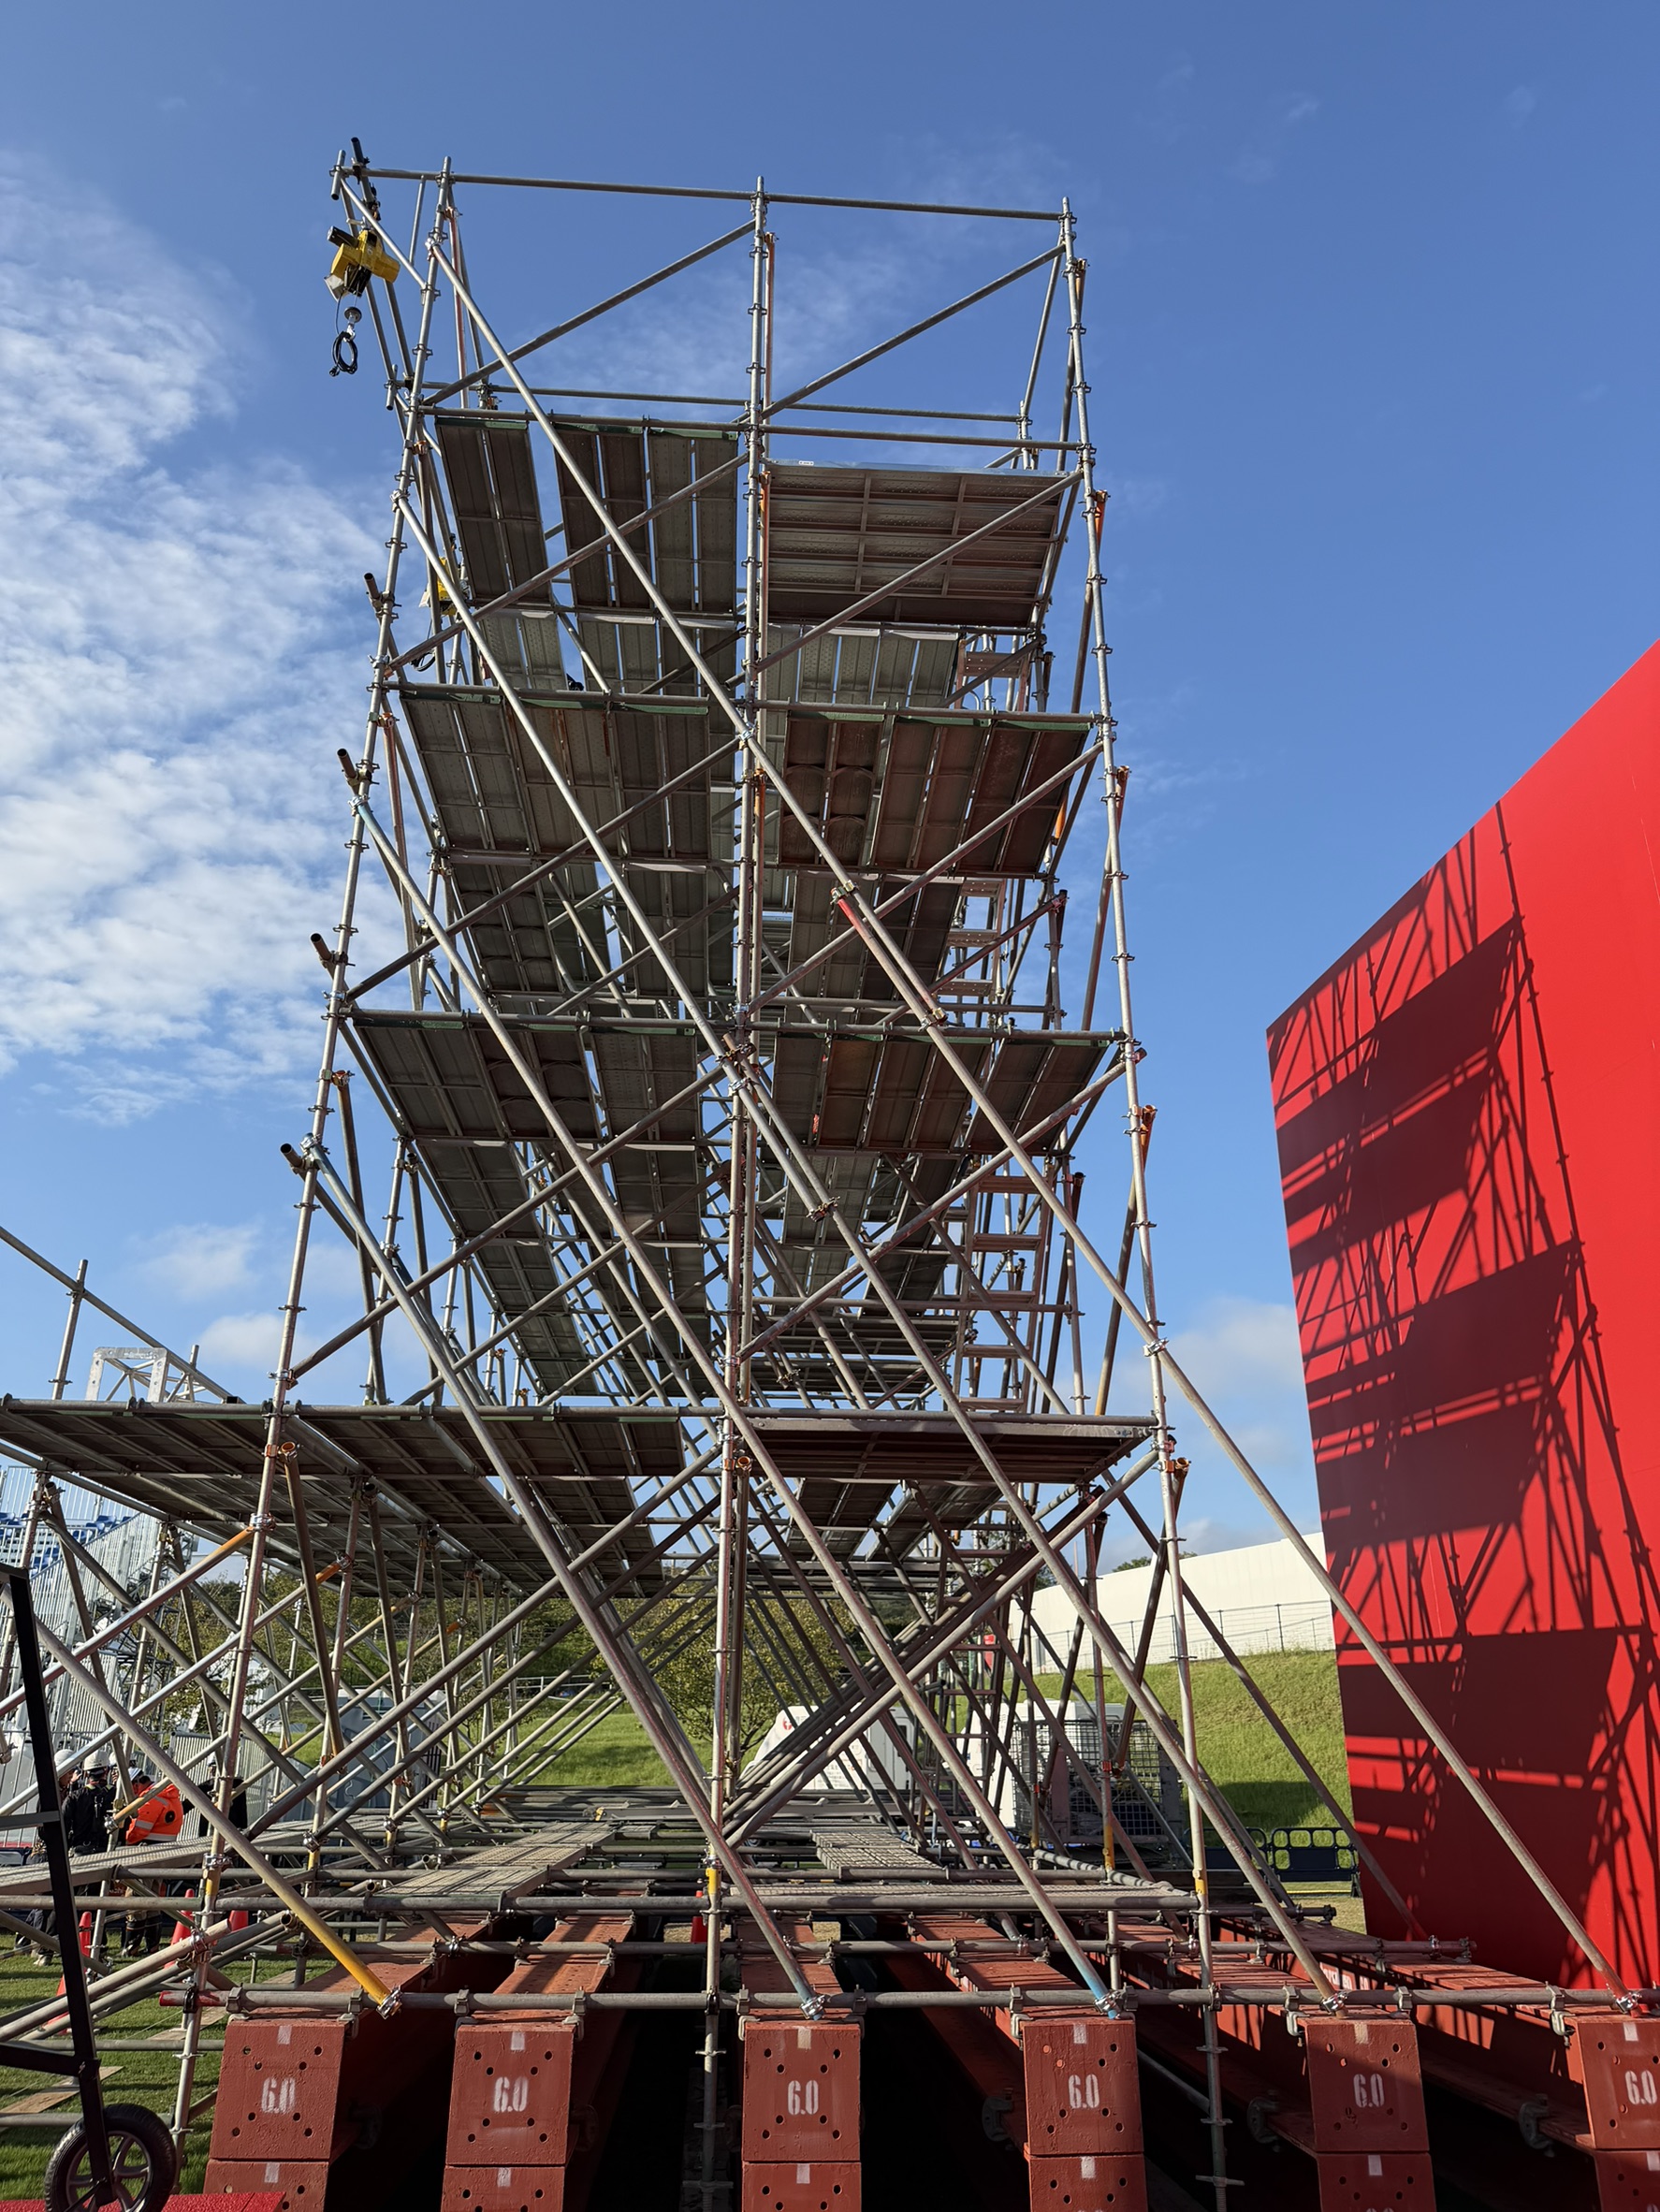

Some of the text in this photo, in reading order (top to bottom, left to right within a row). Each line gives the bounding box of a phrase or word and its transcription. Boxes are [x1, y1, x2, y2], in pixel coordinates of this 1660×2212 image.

[493, 2076, 529, 2113] 6.0
[788, 2080, 819, 2116] 6.0
[1068, 2074, 1100, 2109] 6.0
[1353, 2074, 1385, 2108] 6.0
[1624, 2070, 1658, 2105] 6.0
